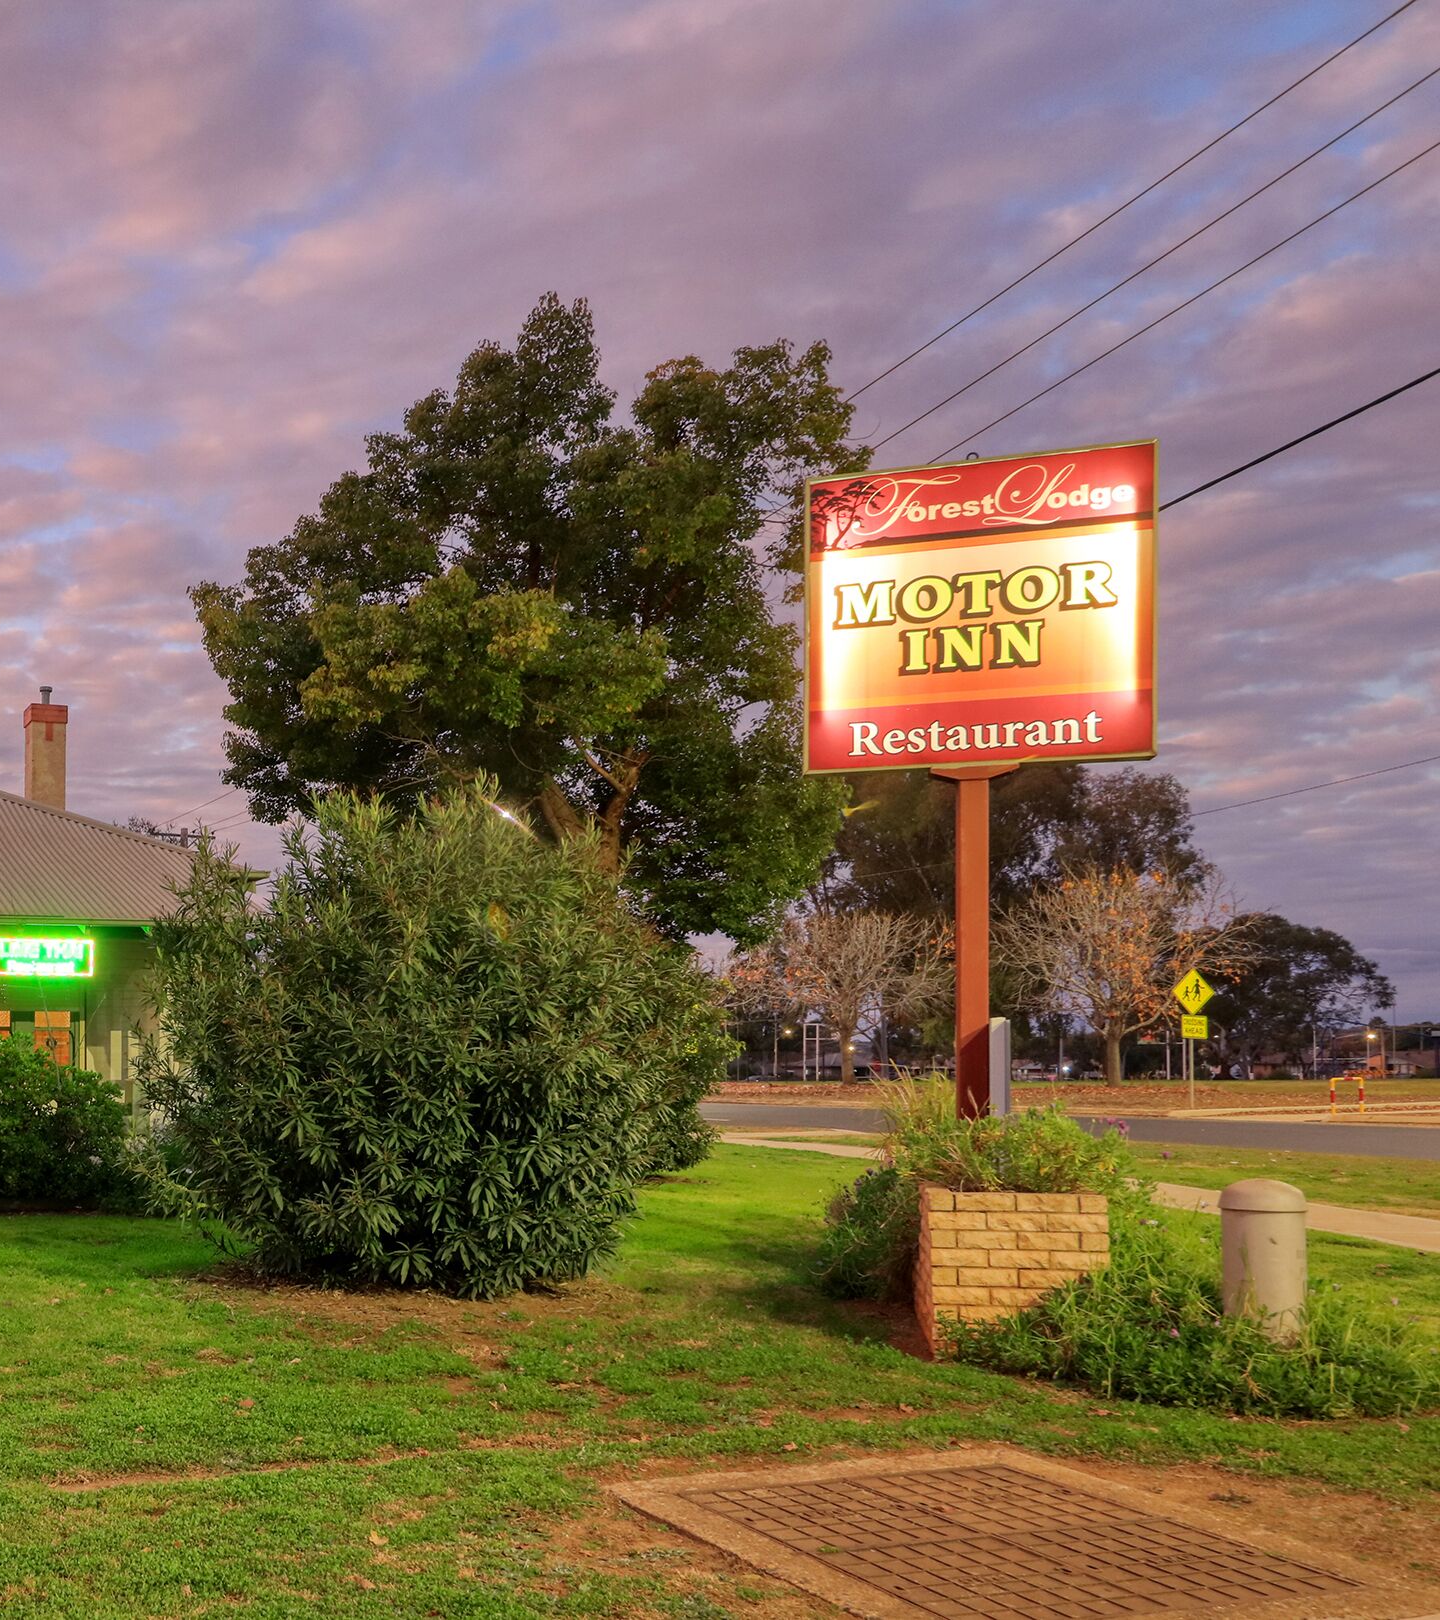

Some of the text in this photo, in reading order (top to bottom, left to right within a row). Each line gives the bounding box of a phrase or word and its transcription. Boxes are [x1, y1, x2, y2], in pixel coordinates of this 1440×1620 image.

[852, 463, 1135, 536] Forest Lodge
[833, 560, 1118, 629] MOTOR
[899, 619, 1045, 676] INN
[848, 710, 1103, 757] Restaurant
